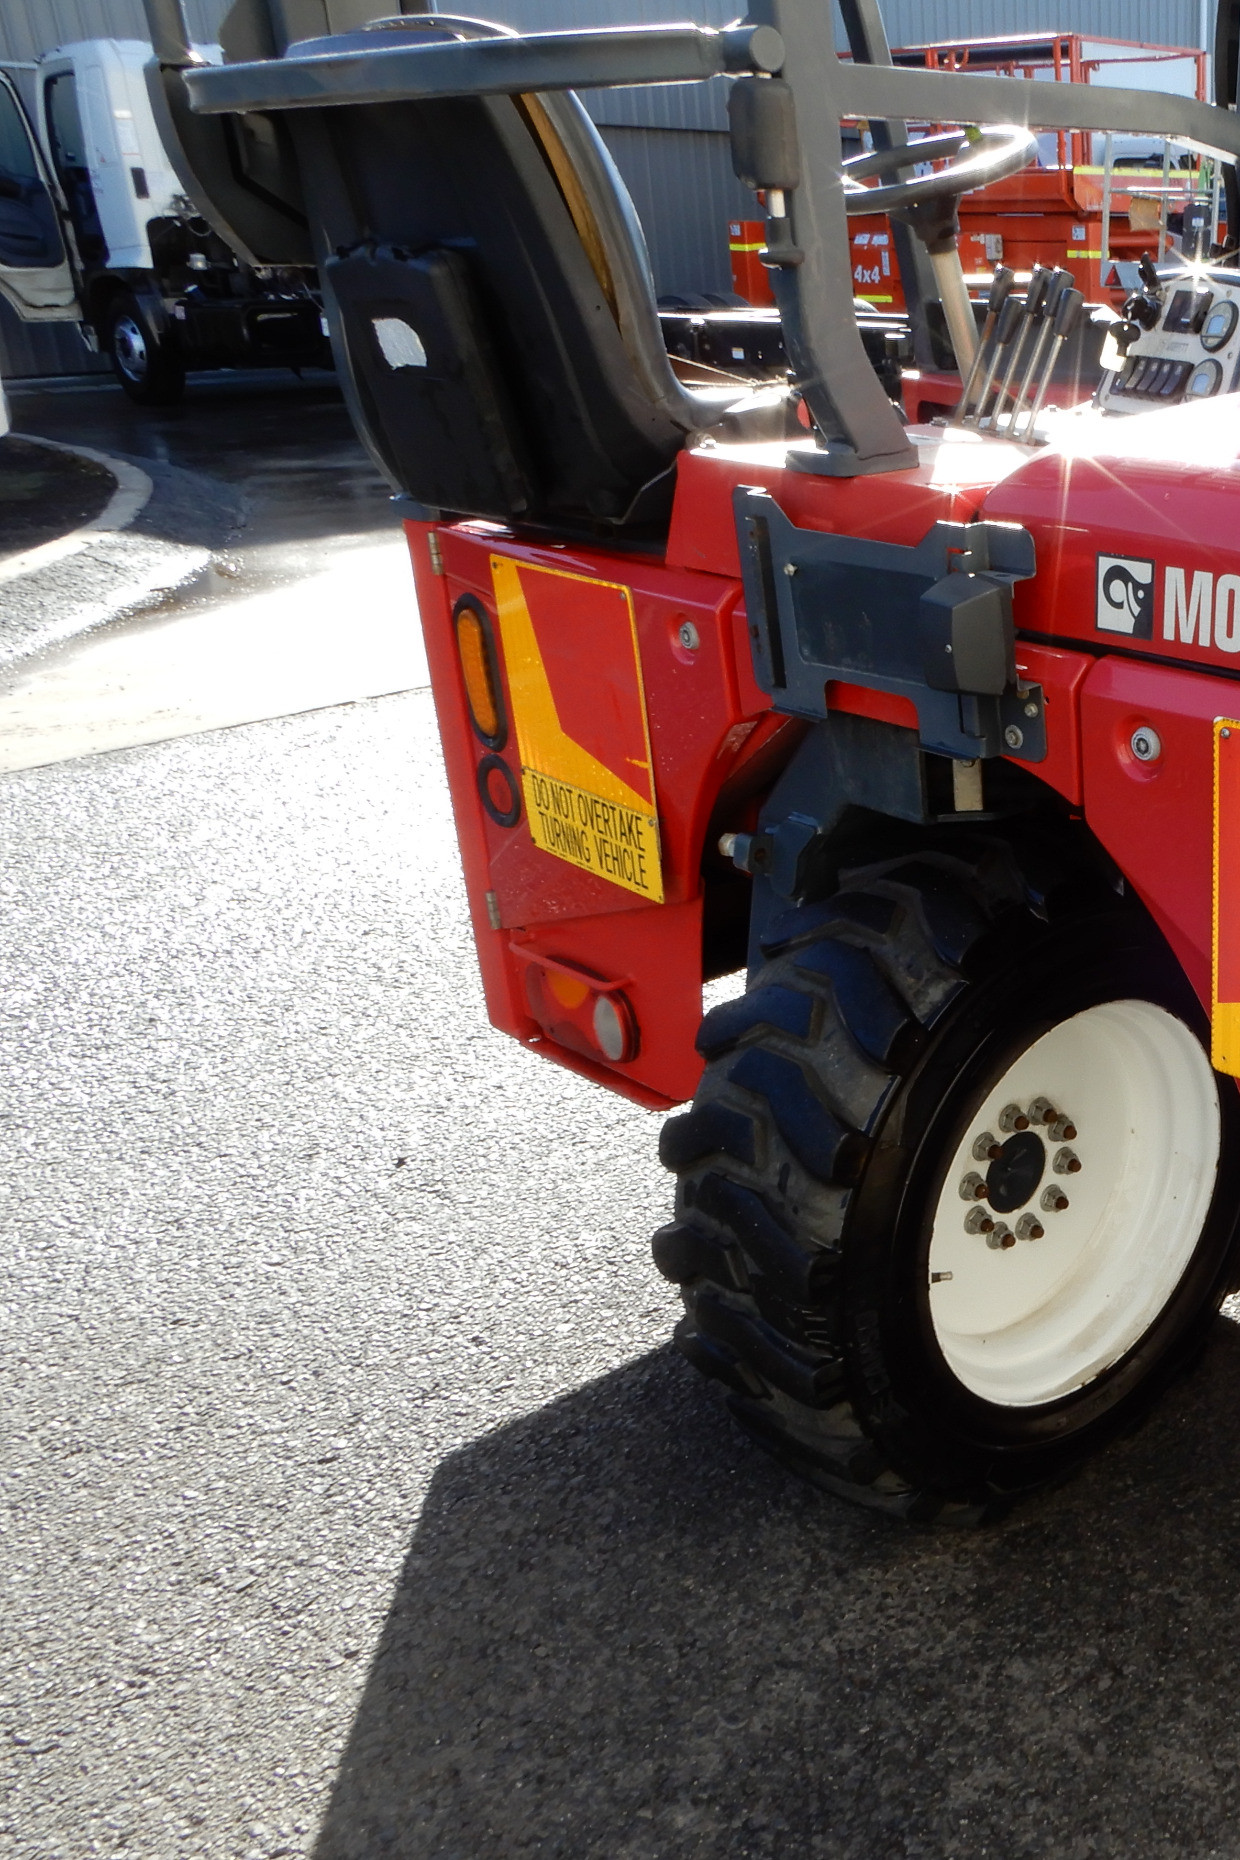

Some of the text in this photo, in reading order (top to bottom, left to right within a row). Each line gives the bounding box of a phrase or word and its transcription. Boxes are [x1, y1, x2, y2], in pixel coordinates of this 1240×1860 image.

[854, 265, 880, 284] 4x4
[531, 774, 646, 852] DO NOT OVERTAKE
[538, 811, 649, 889] TURNING VEHICLE
